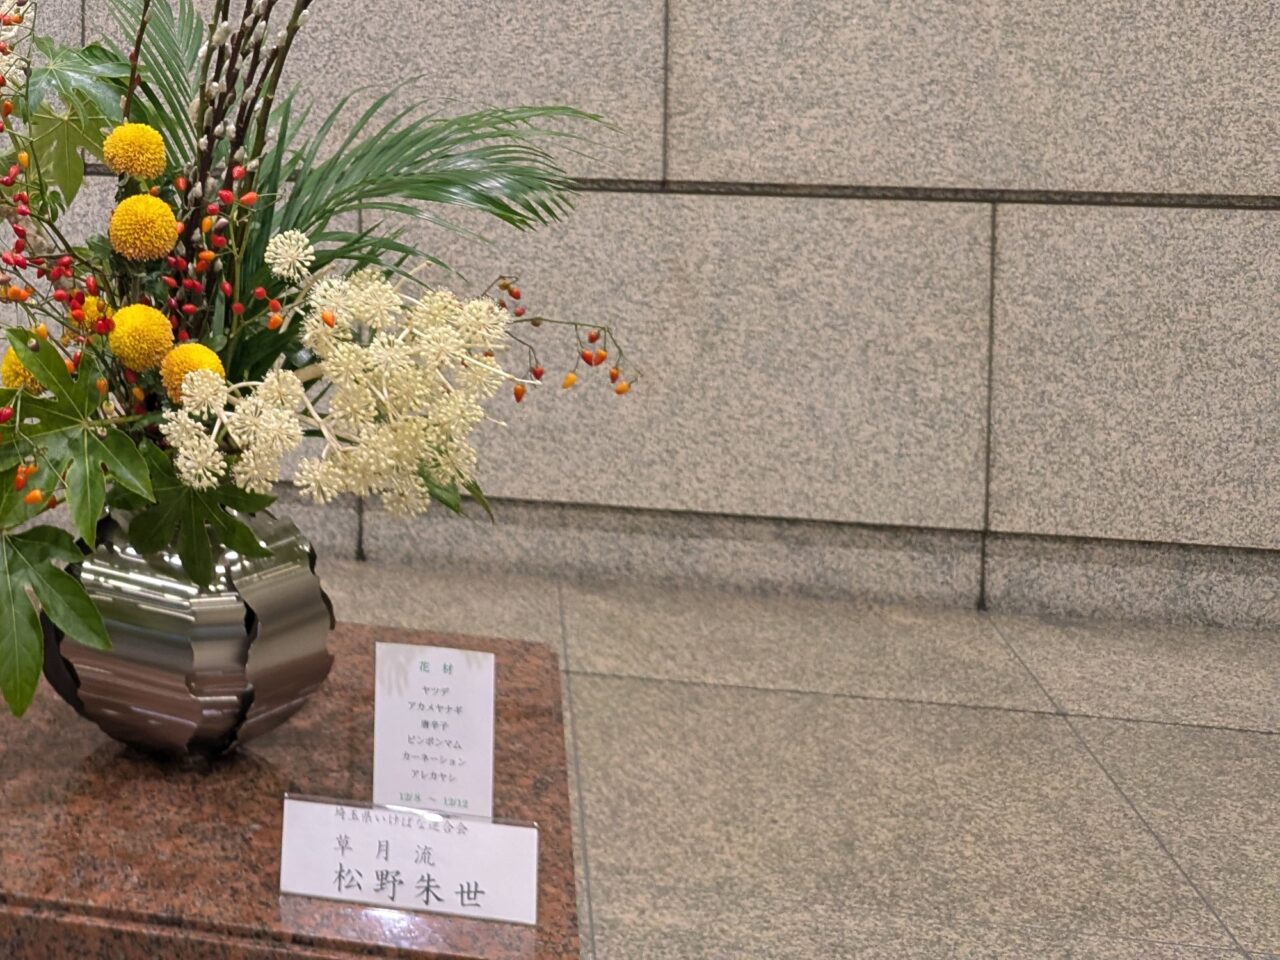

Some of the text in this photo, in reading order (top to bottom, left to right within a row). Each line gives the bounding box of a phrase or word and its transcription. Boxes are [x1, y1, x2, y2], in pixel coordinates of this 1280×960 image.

[422, 685, 450, 696] ヤツデ
[407, 701, 463, 715] アカメヤナギ
[402, 752, 467, 767] カーネーション
[411, 770, 457, 783] アレカヤシ
